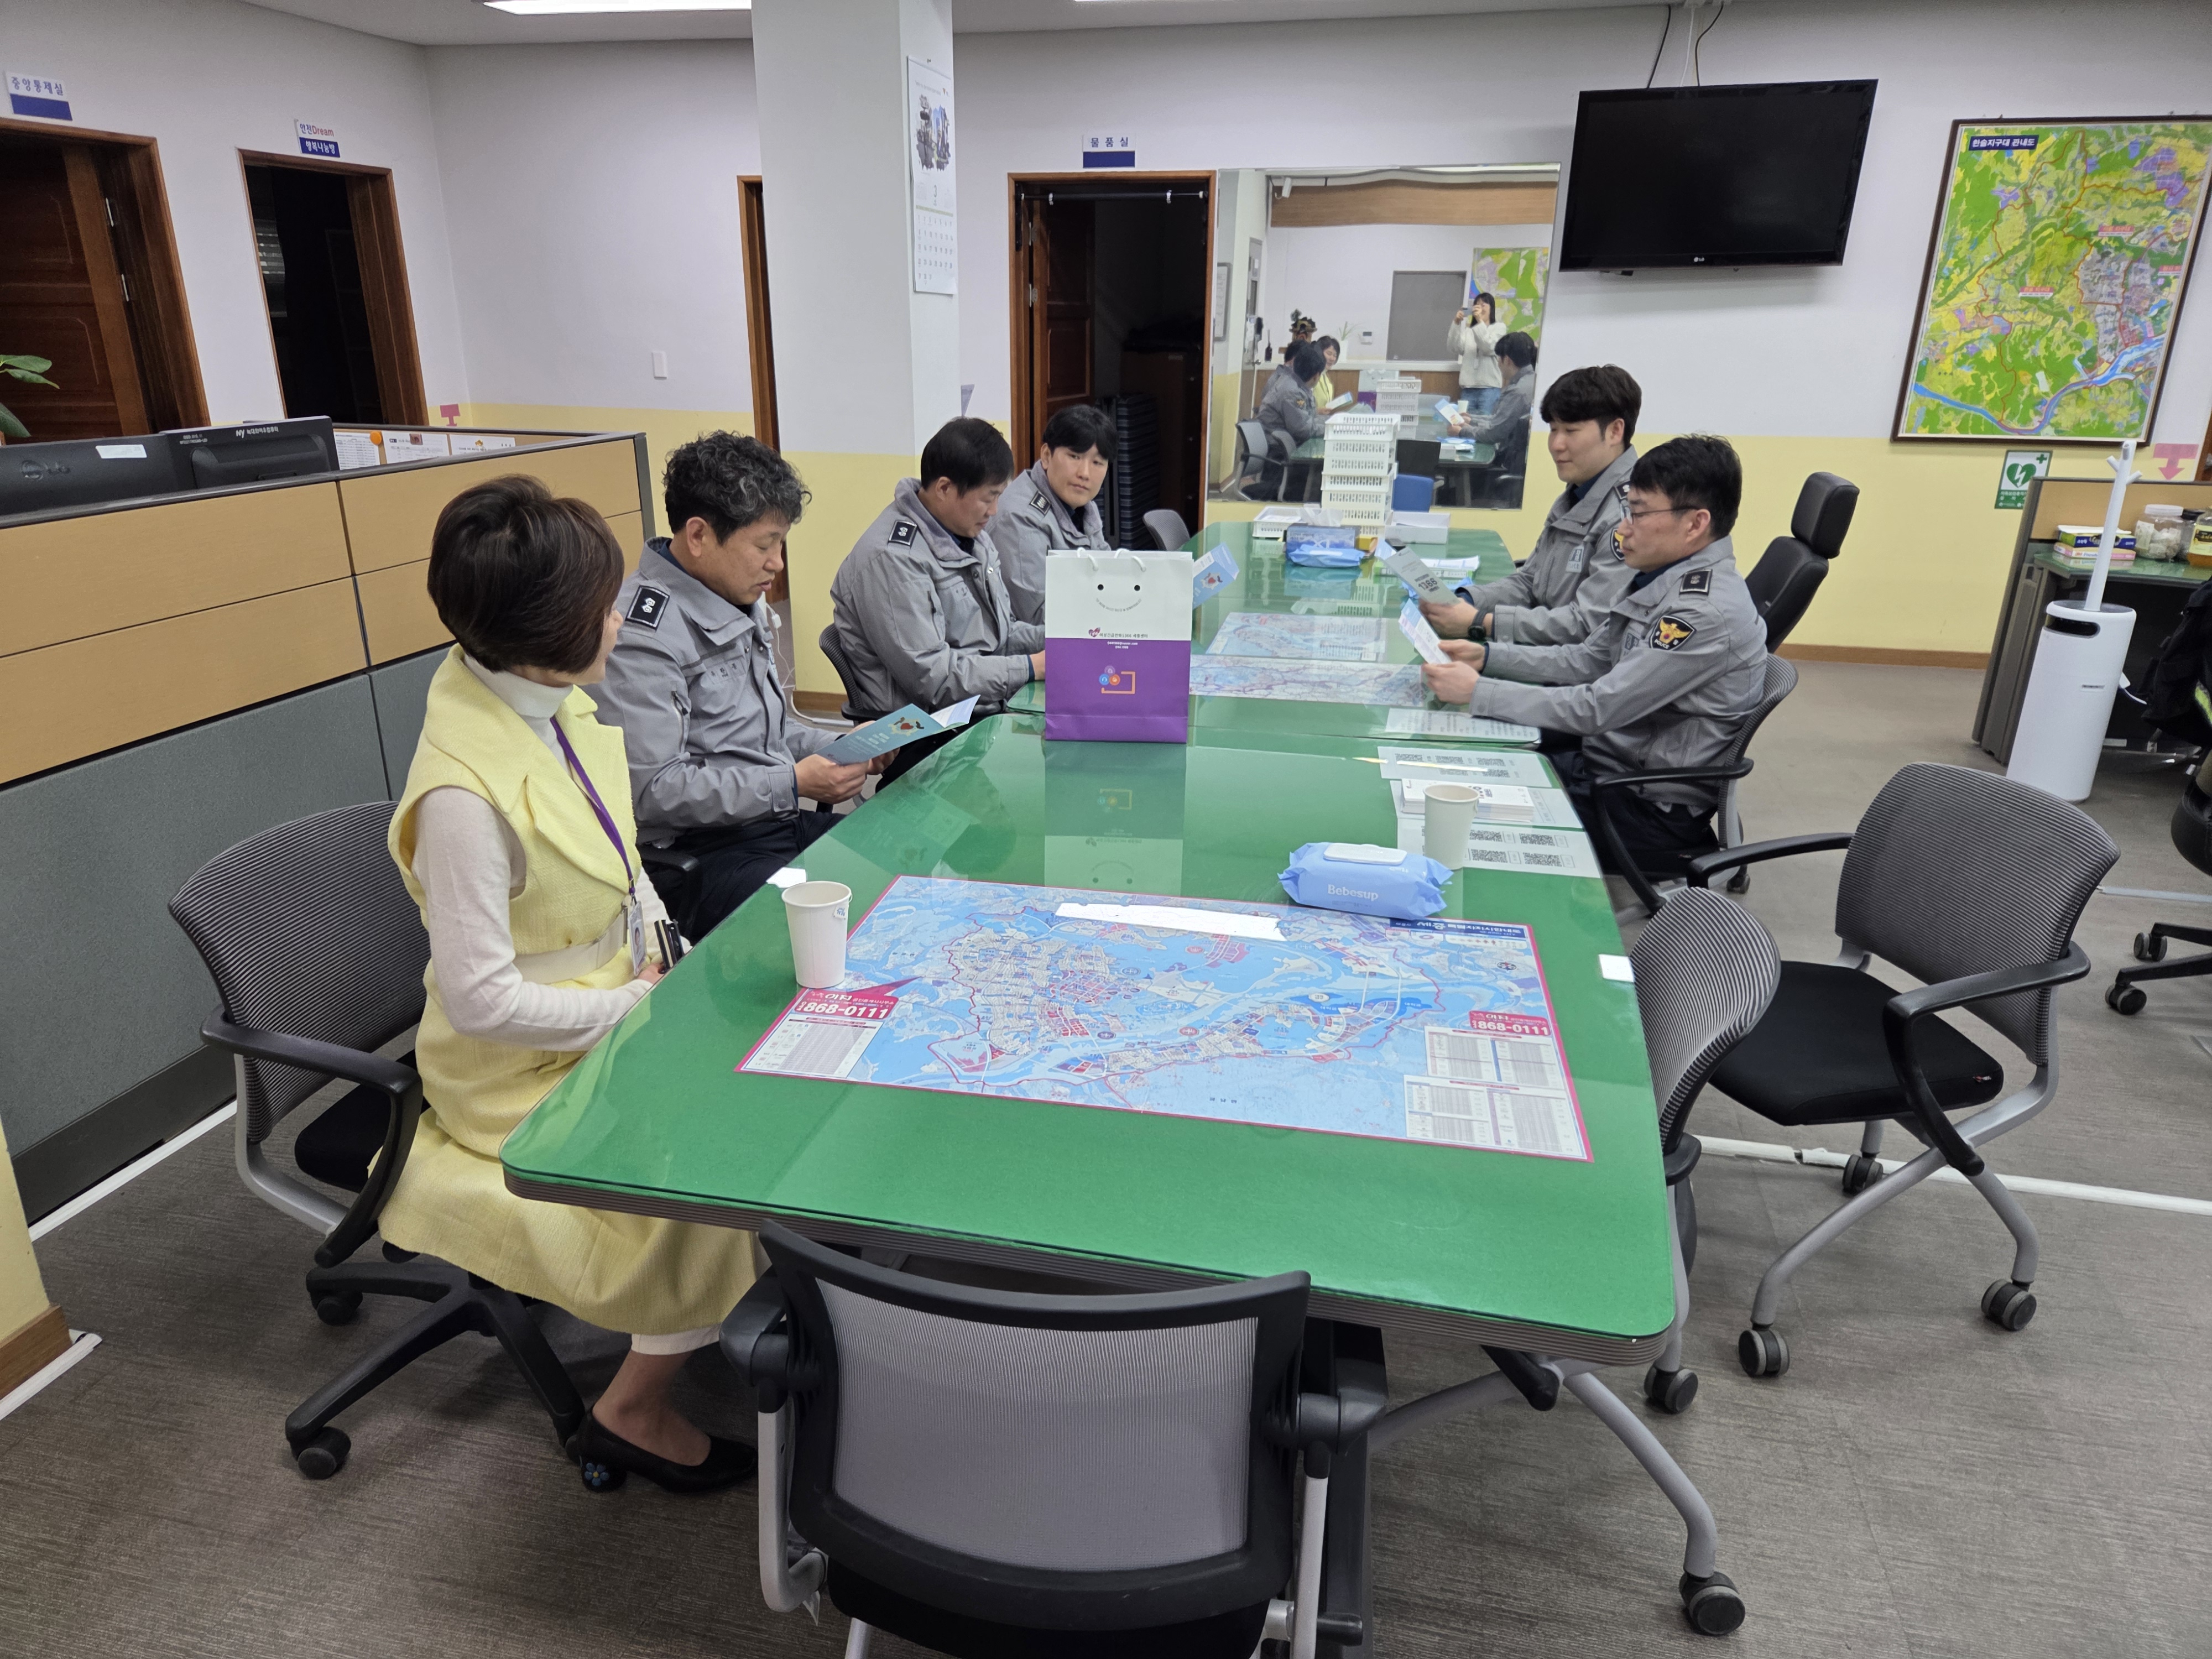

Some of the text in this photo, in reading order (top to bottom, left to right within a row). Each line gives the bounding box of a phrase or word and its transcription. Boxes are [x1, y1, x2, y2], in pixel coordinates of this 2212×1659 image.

[11, 76, 64, 96] 중앙통제실
[299, 123, 334, 137] 안전Dream
[1973, 138, 2035, 147] 한솔지구대 관내도
[1418, 577, 1438, 591] 1366
[1654, 639, 1670, 649] POLICE
[1328, 884, 1379, 902] Bebesup
[804, 1002, 889, 1019] 868-0111
[1478, 1021, 1548, 1035] 868-0111
